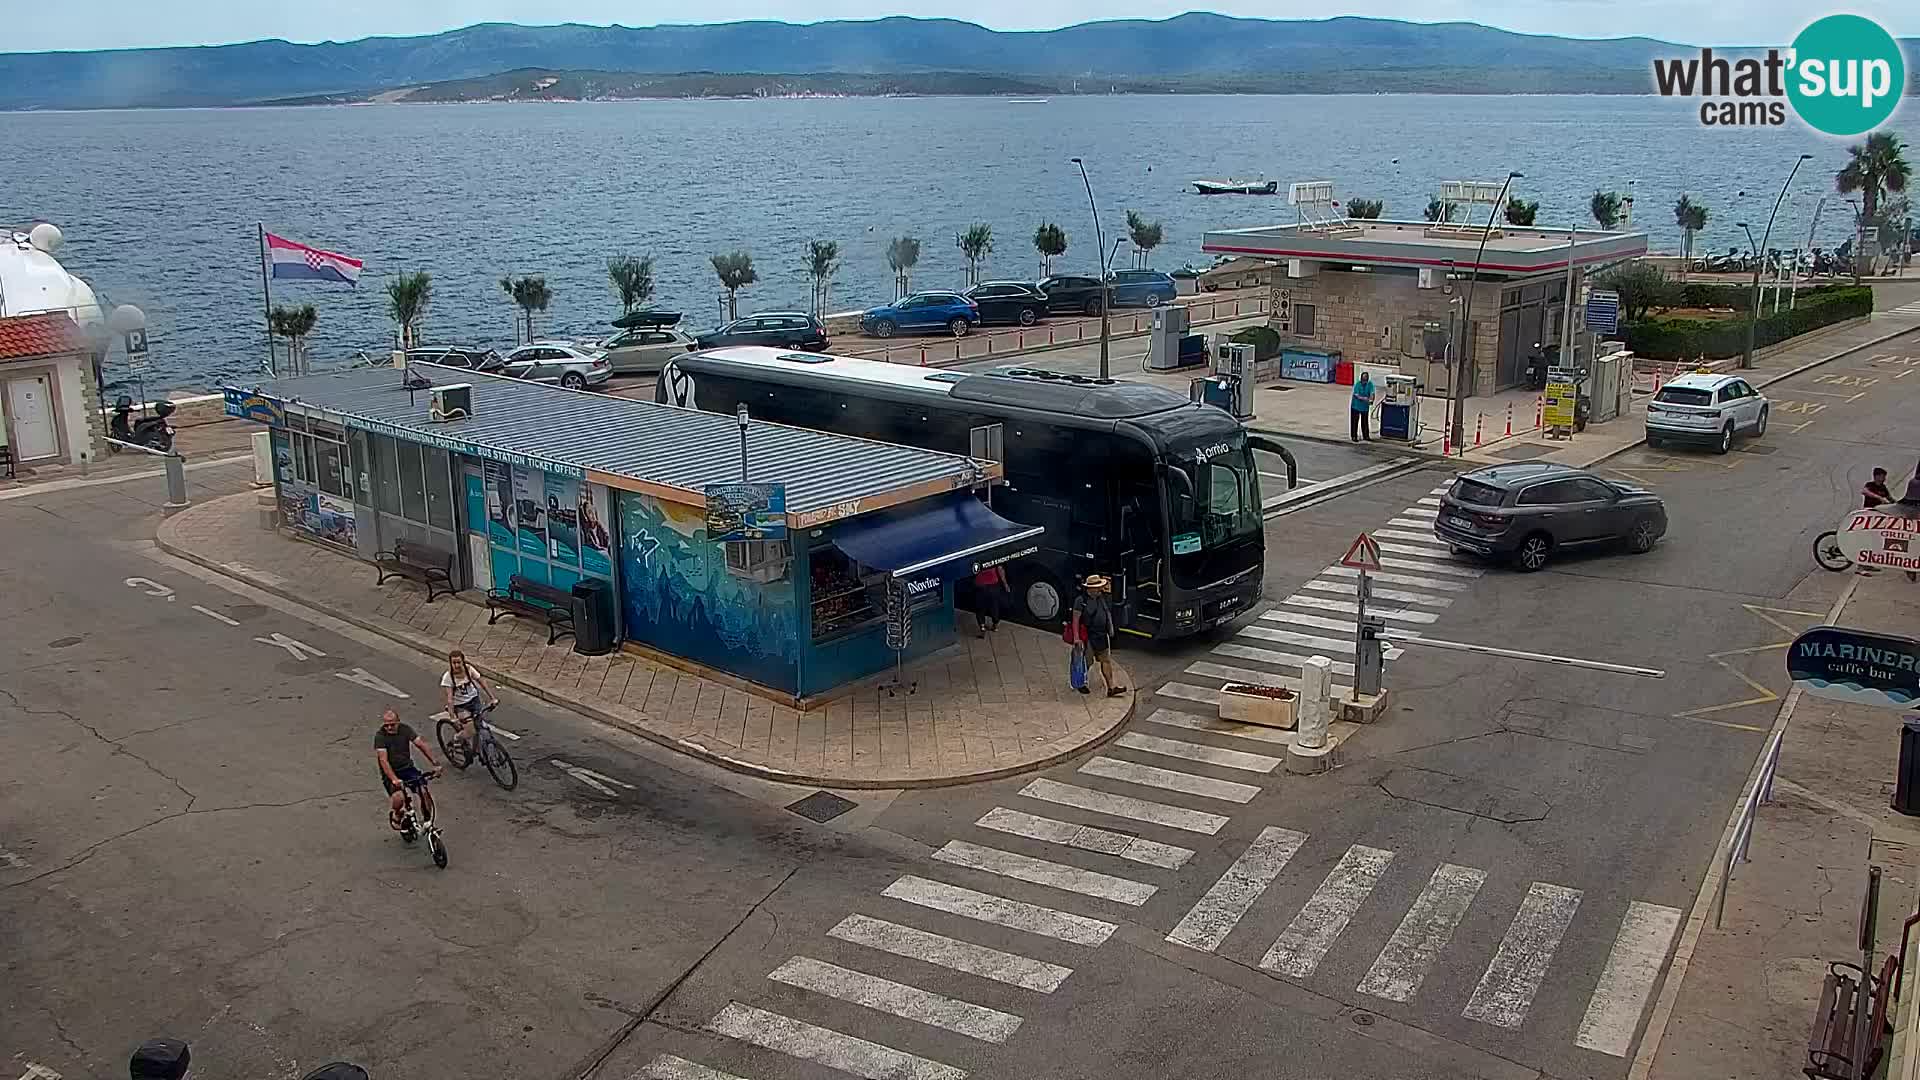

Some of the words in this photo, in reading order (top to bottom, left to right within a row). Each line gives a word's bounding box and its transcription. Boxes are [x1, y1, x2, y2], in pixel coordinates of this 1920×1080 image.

[1812, 373, 1880, 388] TAXI
[477, 446, 492, 458] BUS
[492, 450, 526, 466] STATION
[527, 457, 554, 473] TICKET
[554, 463, 582, 478] OFFICE
[1880, 530, 1916, 541] GRILL
[1869, 665, 1896, 681] bar
